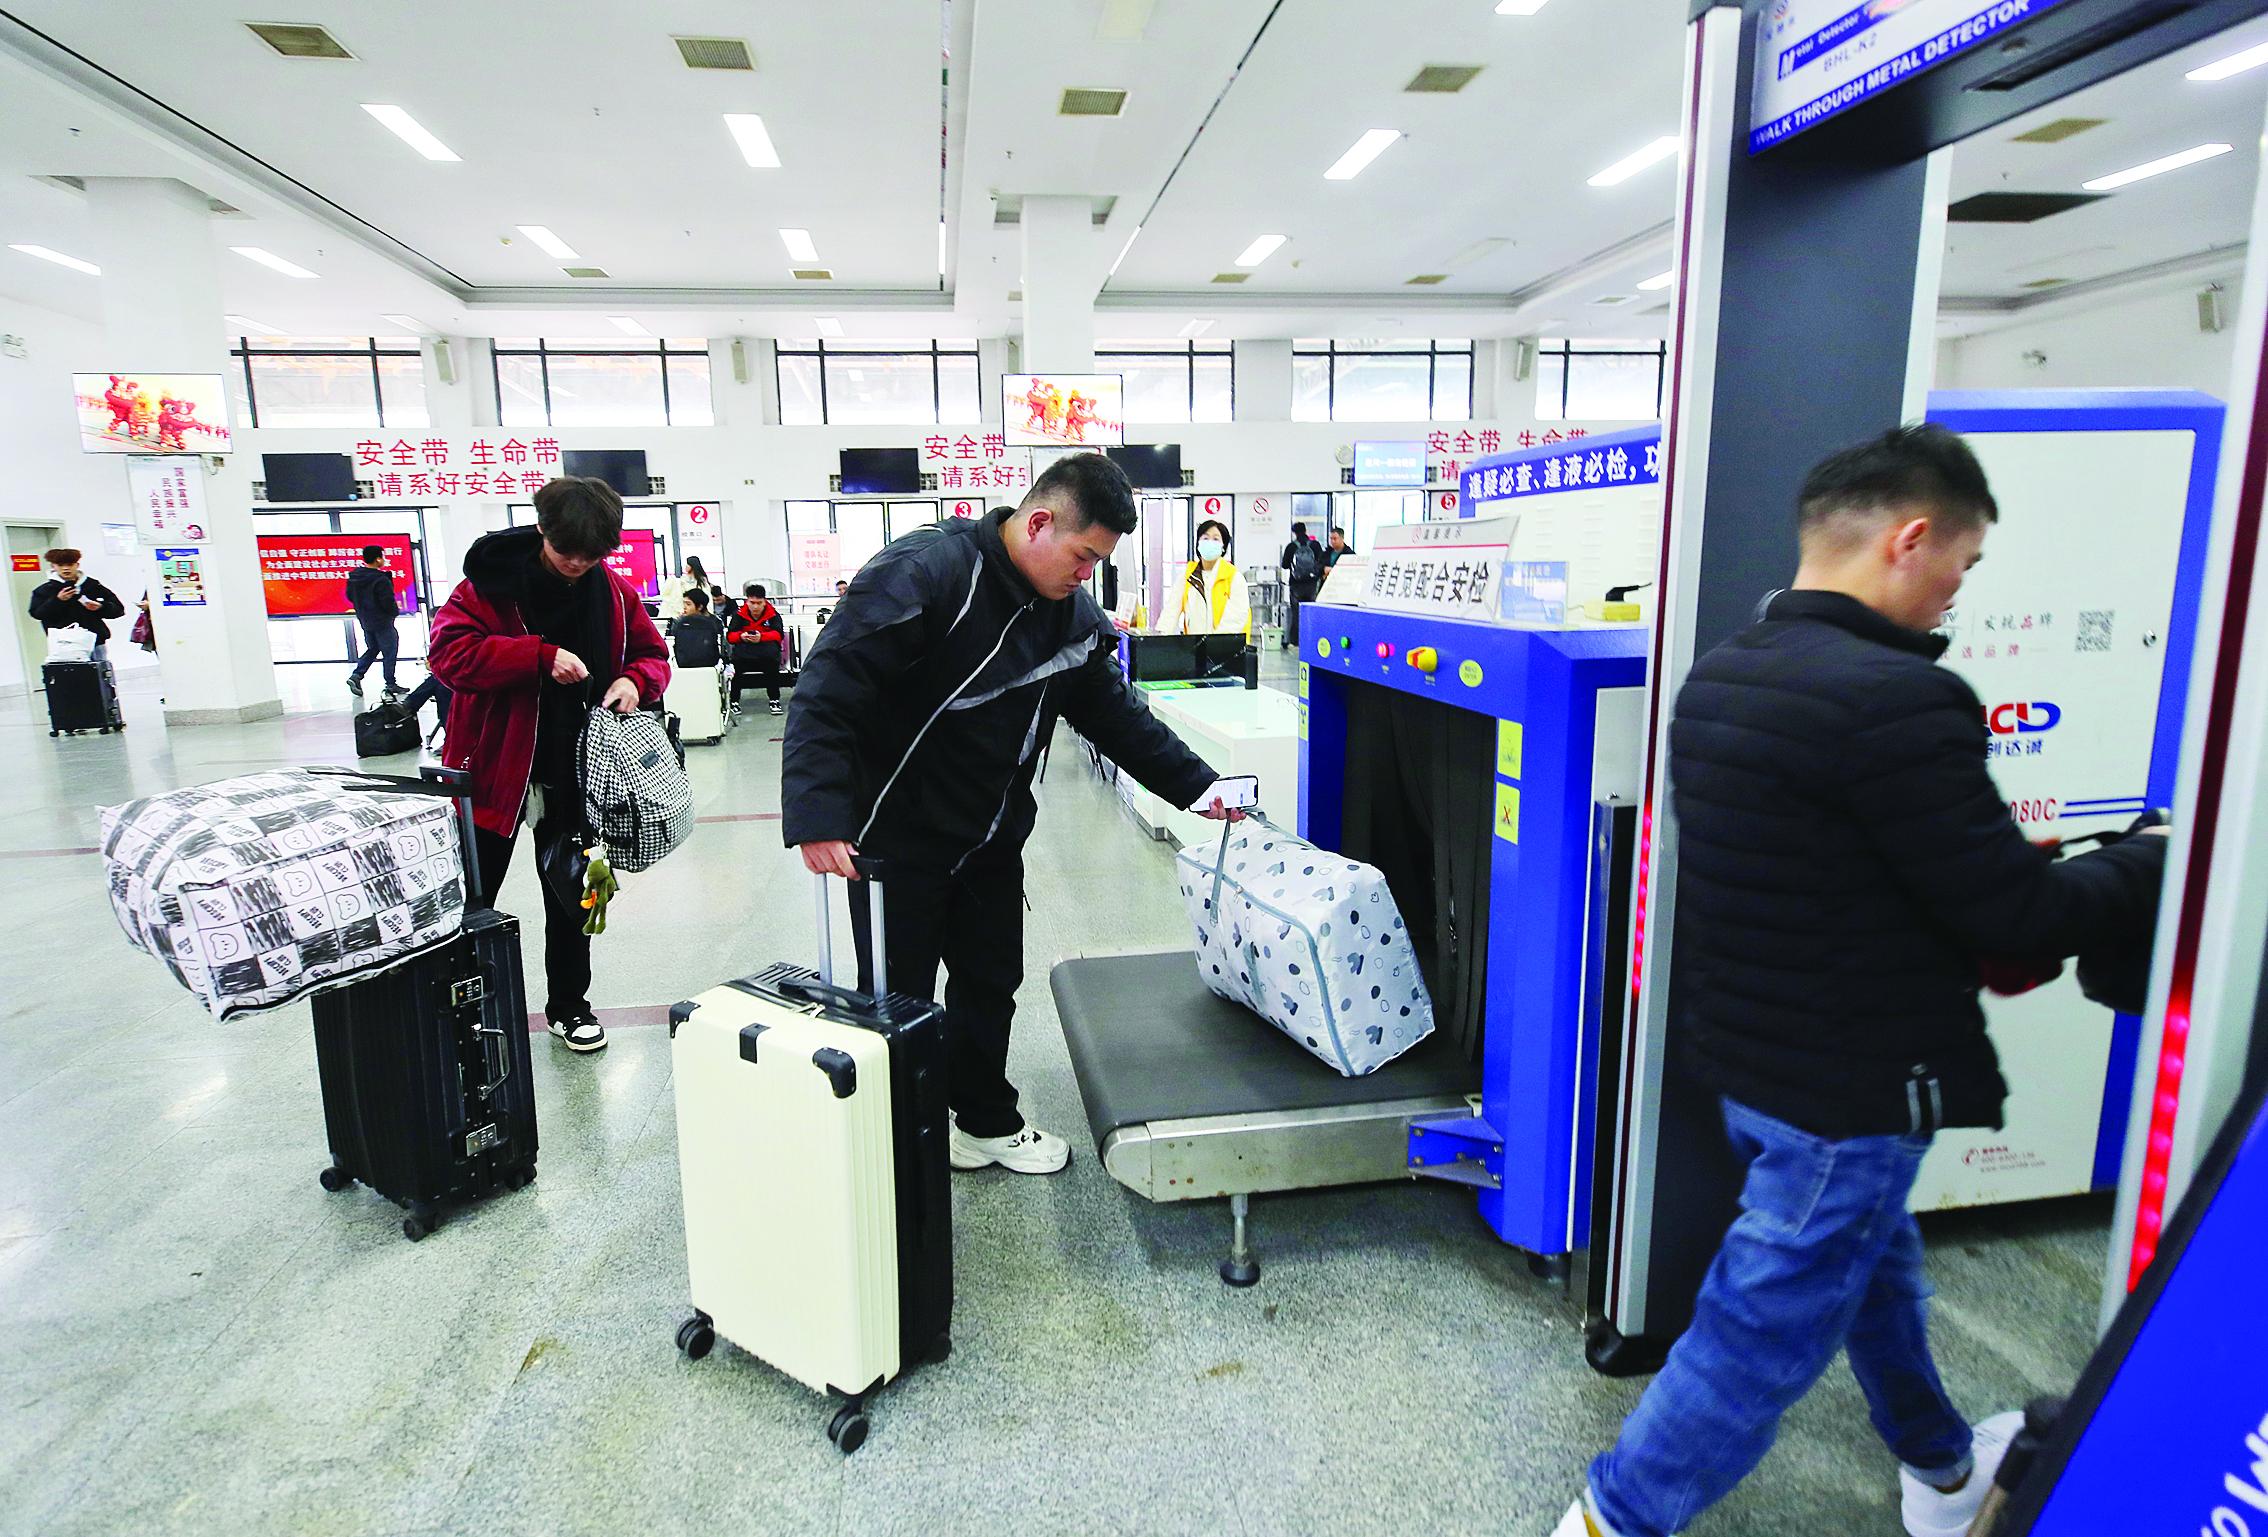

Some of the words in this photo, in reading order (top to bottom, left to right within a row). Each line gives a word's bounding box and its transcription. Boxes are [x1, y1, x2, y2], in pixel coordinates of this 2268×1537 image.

[1818, 12, 1860, 44] Detector
[1755, 117, 1792, 146] WALK
[1794, 79, 1864, 126] THROUGH
[1866, 52, 1921, 91] METAL
[1924, 0, 2029, 61] DETECTOR
[356, 439, 449, 466] 安全带
[470, 437, 560, 465] 生命带
[925, 434, 1004, 459] 安全带
[1428, 430, 1501, 454] 安全带
[377, 471, 545, 497] 请系好安全带
[1372, 560, 1490, 603] 请自觉配合安检
